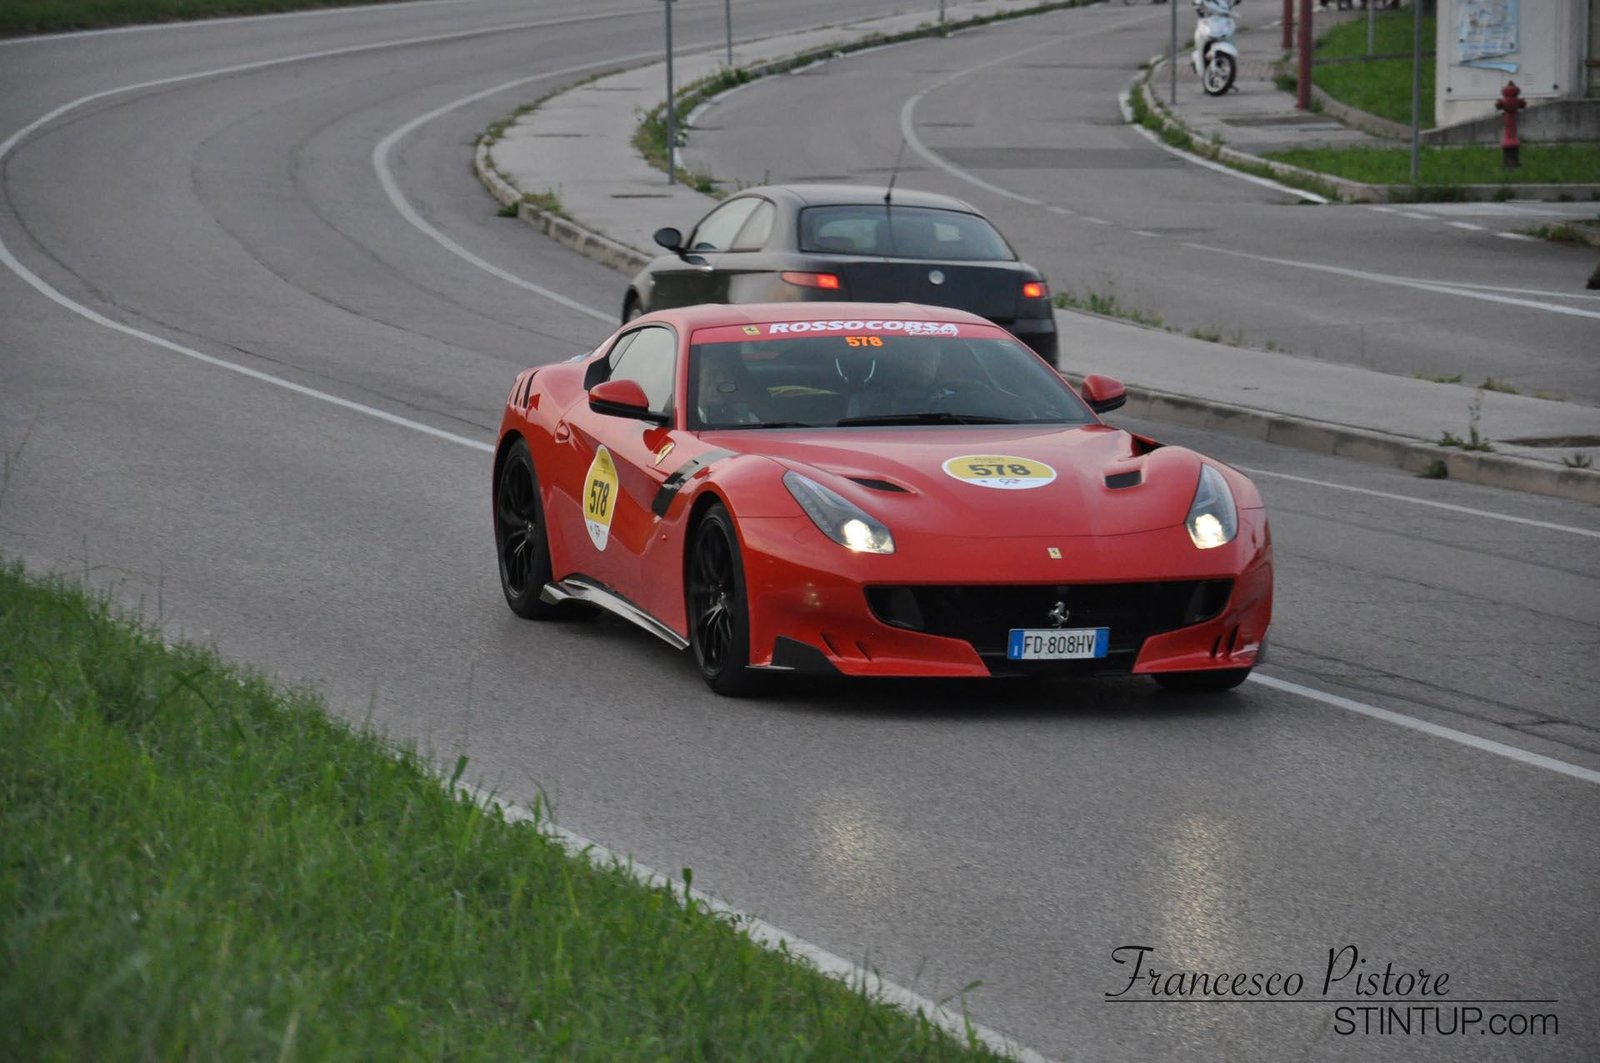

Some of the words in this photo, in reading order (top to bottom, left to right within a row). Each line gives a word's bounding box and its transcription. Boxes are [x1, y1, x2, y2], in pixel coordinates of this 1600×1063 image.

[769, 321, 959, 334] ROSSOCORSA
[846, 336, 883, 347] 578
[968, 464, 1031, 476] 578
[589, 479, 609, 517] 578
